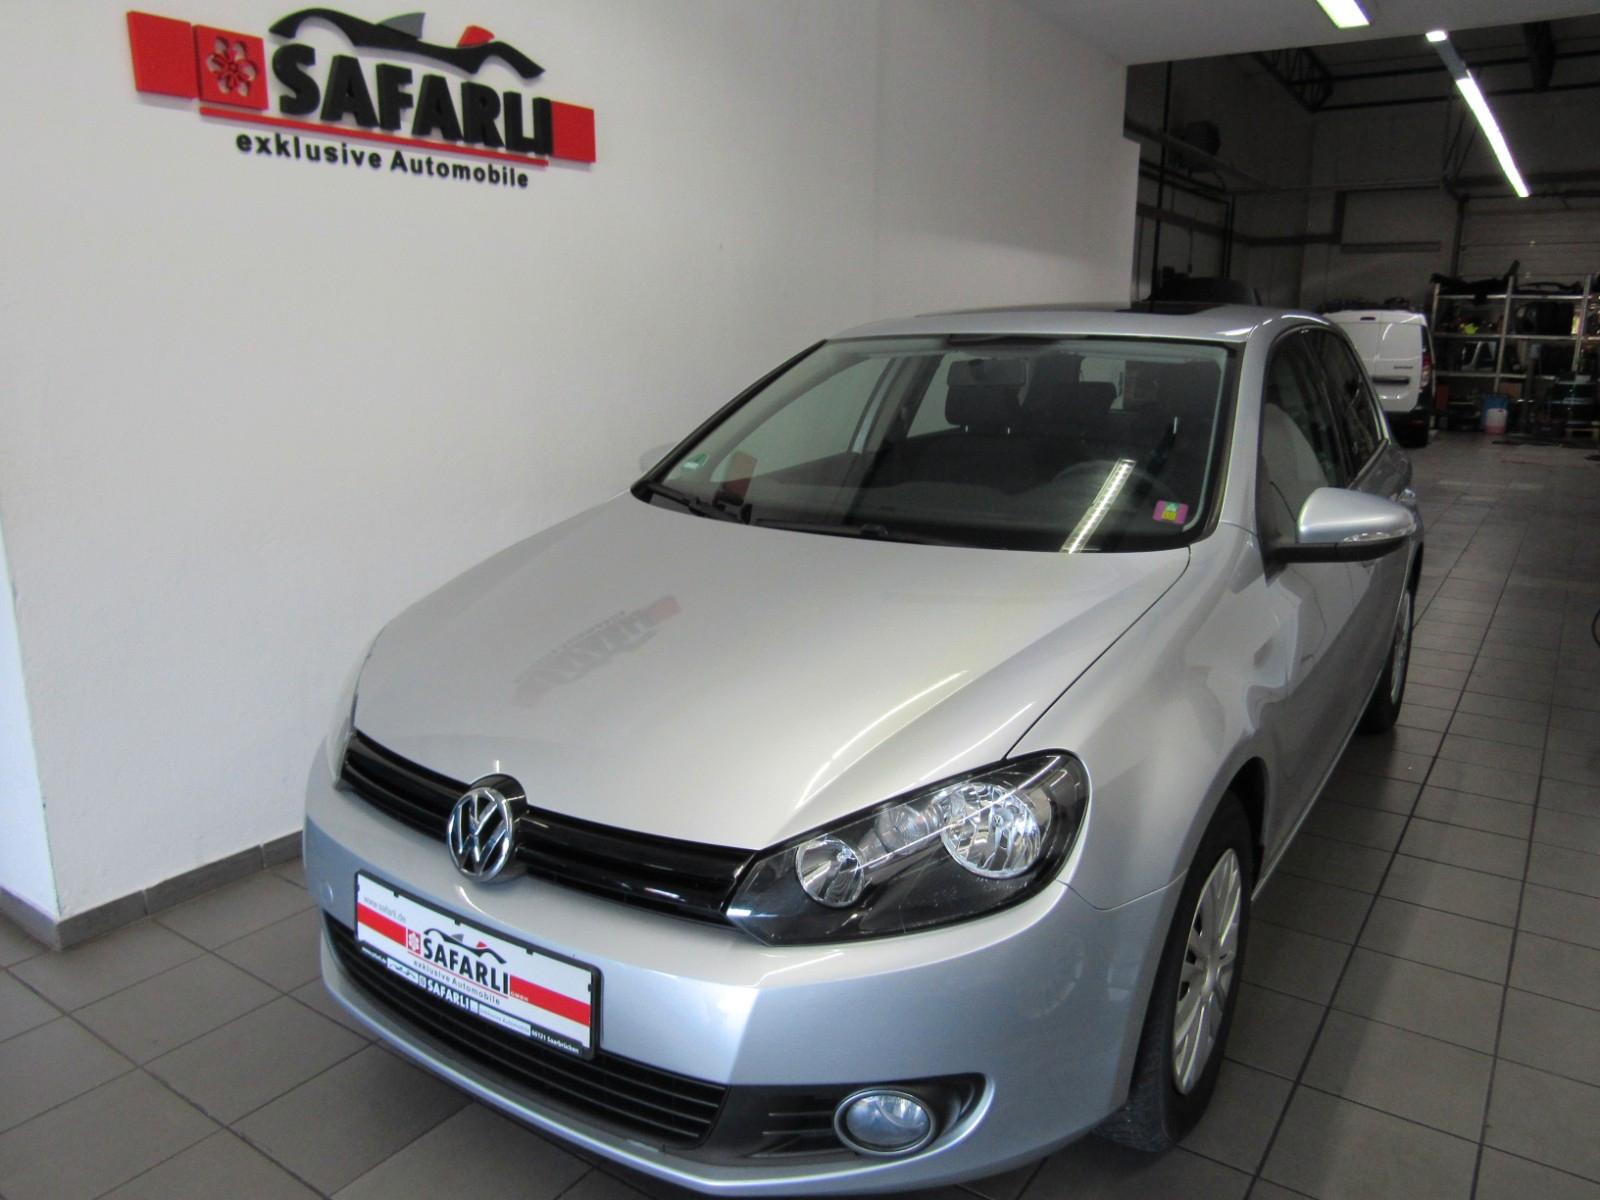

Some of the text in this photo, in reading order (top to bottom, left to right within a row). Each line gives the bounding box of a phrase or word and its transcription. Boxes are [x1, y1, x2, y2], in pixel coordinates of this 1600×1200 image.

[271, 43, 553, 156] SAFARLI
[236, 131, 529, 188] exklusive Automobile
[413, 960, 501, 1006] exklusive Automobile
[423, 937, 509, 995] SAFARLI
[427, 978, 471, 1010] SAFARLI
